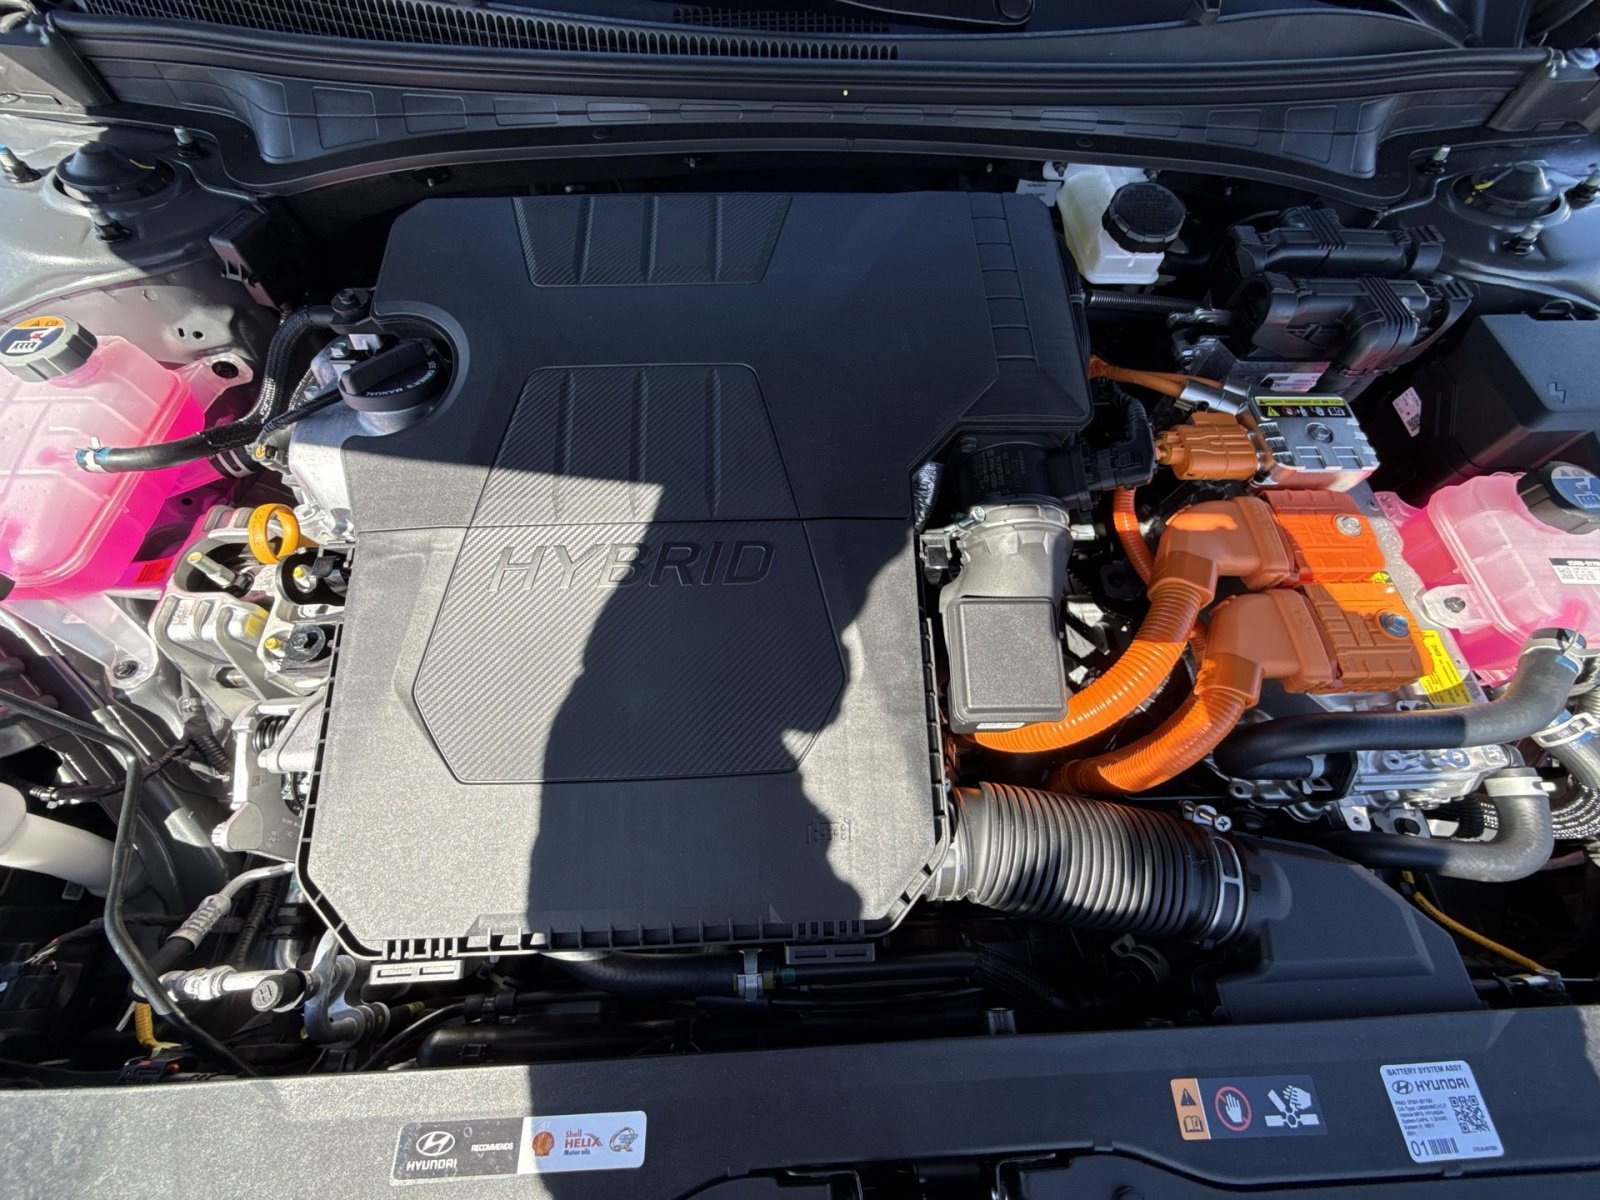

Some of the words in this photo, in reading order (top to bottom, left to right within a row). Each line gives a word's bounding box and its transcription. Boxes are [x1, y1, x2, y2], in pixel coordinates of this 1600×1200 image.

[365, 387, 403, 397] MANUAL
[488, 540, 777, 592] HYBRID
[1386, 1067, 1417, 1076] BATTERY
[1417, 1065, 1445, 1074] SYSTEM
[1415, 1077, 1470, 1092] HYUNDAI
[565, 1129, 582, 1138] Shell
[471, 1142, 514, 1152] RECOMMENDS
[564, 1137, 602, 1149] HELIX
[1410, 1140, 1429, 1156] 01
[406, 1158, 457, 1171] HYUNDAI
